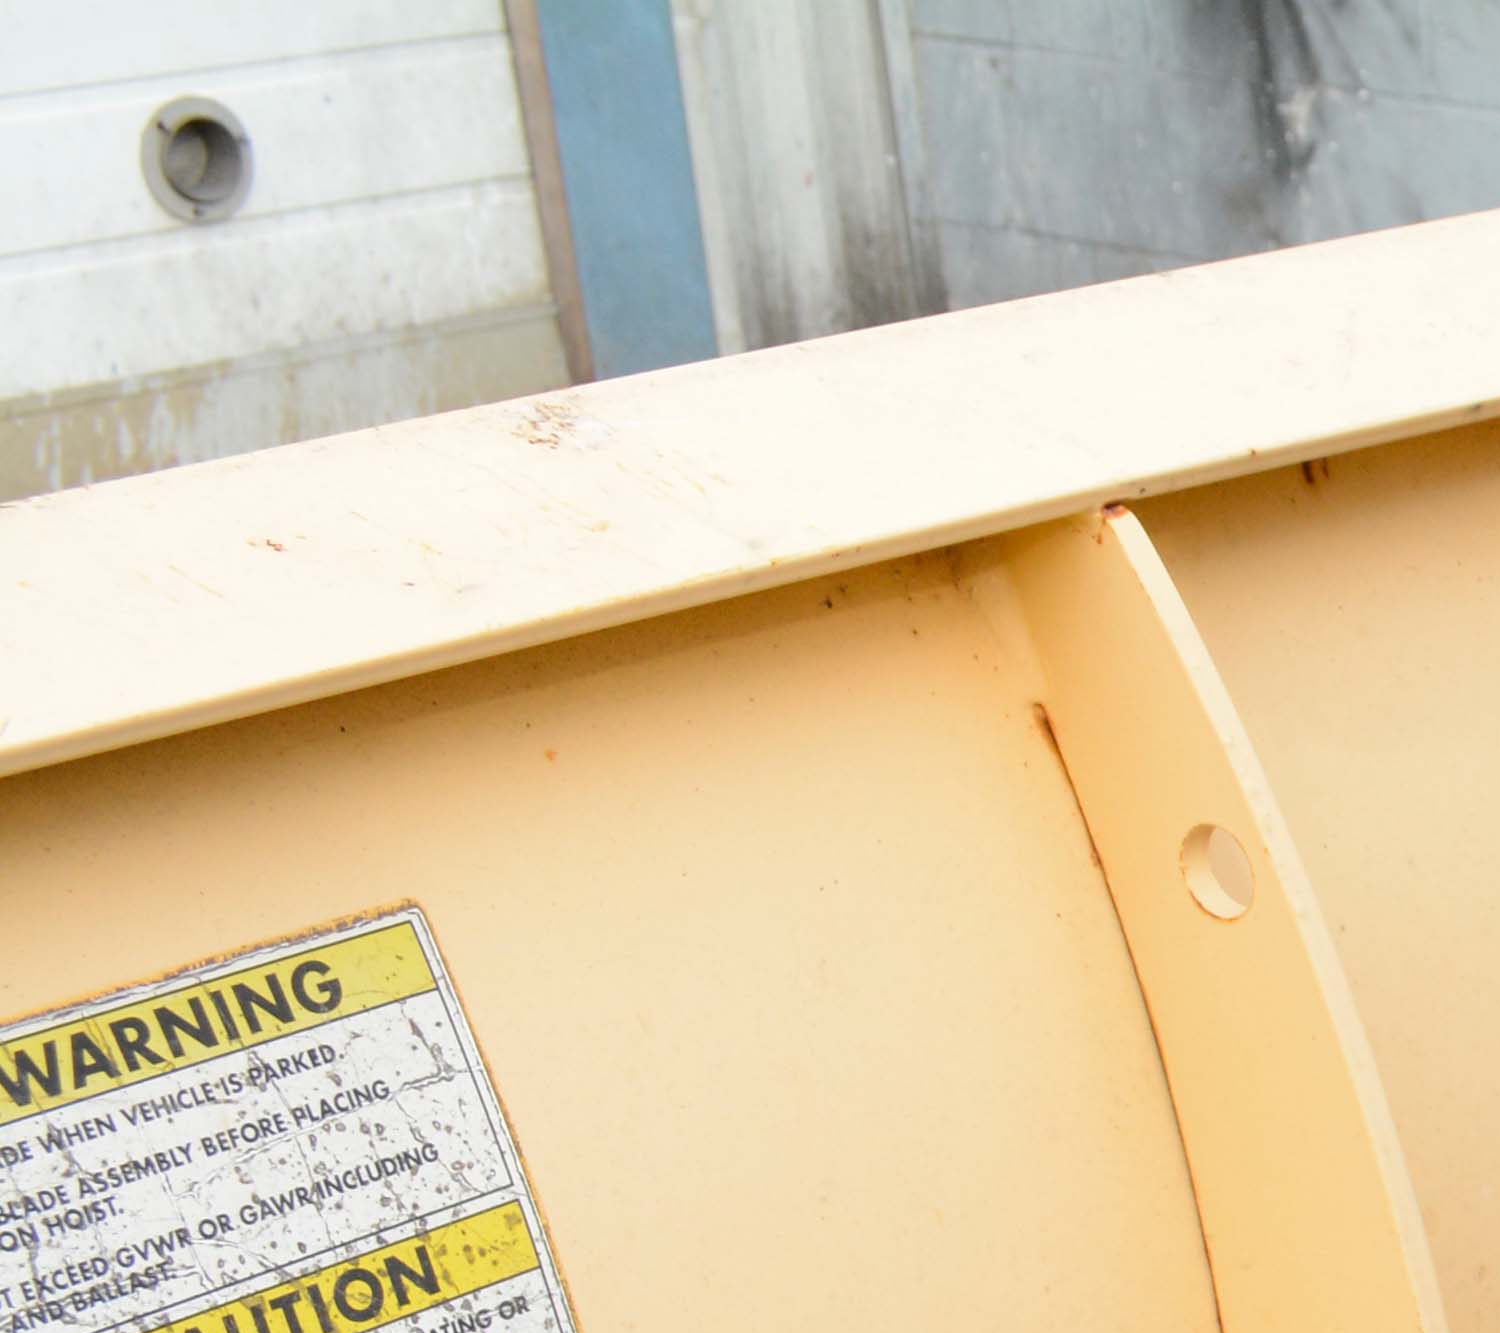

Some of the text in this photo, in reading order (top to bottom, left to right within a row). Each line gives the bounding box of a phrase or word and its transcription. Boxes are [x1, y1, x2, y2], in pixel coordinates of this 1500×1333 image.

[0, 960, 342, 1107] WARNING
[36, 1114, 117, 1153] WHEN
[120, 1082, 216, 1126] VEHICLE
[220, 1073, 243, 1096] IS
[248, 1044, 345, 1086] PARKED.
[78, 1142, 193, 1199] ASSEMBLY
[200, 1113, 288, 1157] BEFORE
[290, 1080, 390, 1127] PLACING
[0, 1196, 125, 1251] ON HOIST.
[20, 1257, 109, 1301] EXCEED
[116, 1228, 193, 1268] GVWR
[198, 1213, 235, 1240] OR
[239, 1186, 313, 1225] GAWR
[315, 1143, 439, 1200] INCLUDING
[11, 1261, 177, 1333] AND BALLAST.
[500, 1295, 530, 1320] OR
